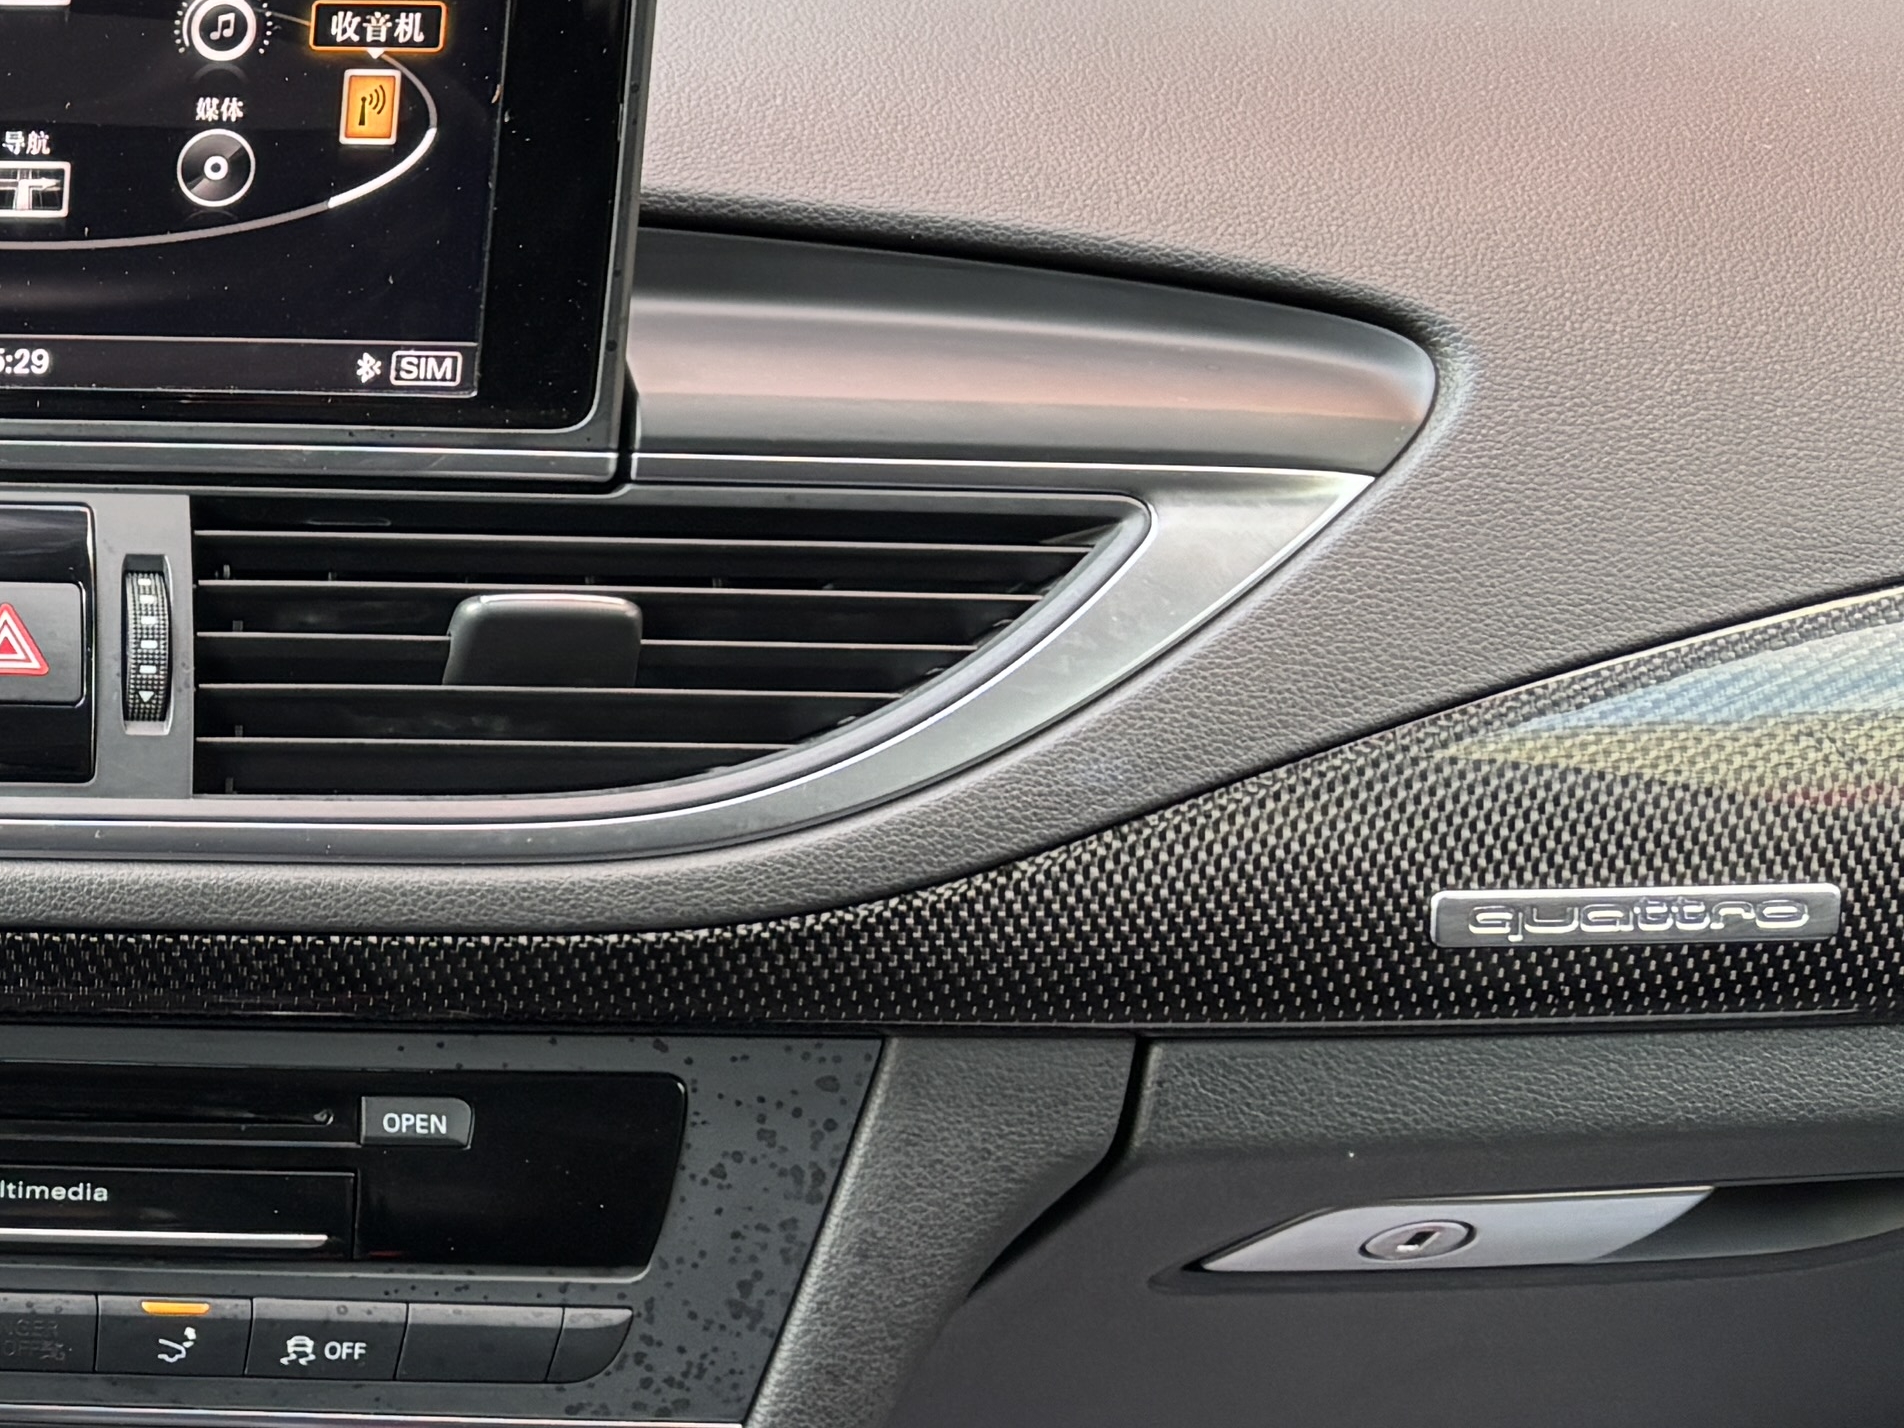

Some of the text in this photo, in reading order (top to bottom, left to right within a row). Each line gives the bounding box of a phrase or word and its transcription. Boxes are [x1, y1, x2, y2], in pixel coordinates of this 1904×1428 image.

[330, 10, 425, 44] 收音机
[195, 96, 244, 122] 媒体
[2, 131, 51, 156] 导航
[398, 356, 455, 382] SIM
[1467, 896, 1811, 943] quattro
[381, 1112, 448, 1135] OPEN
[323, 1341, 367, 1361] OFF
